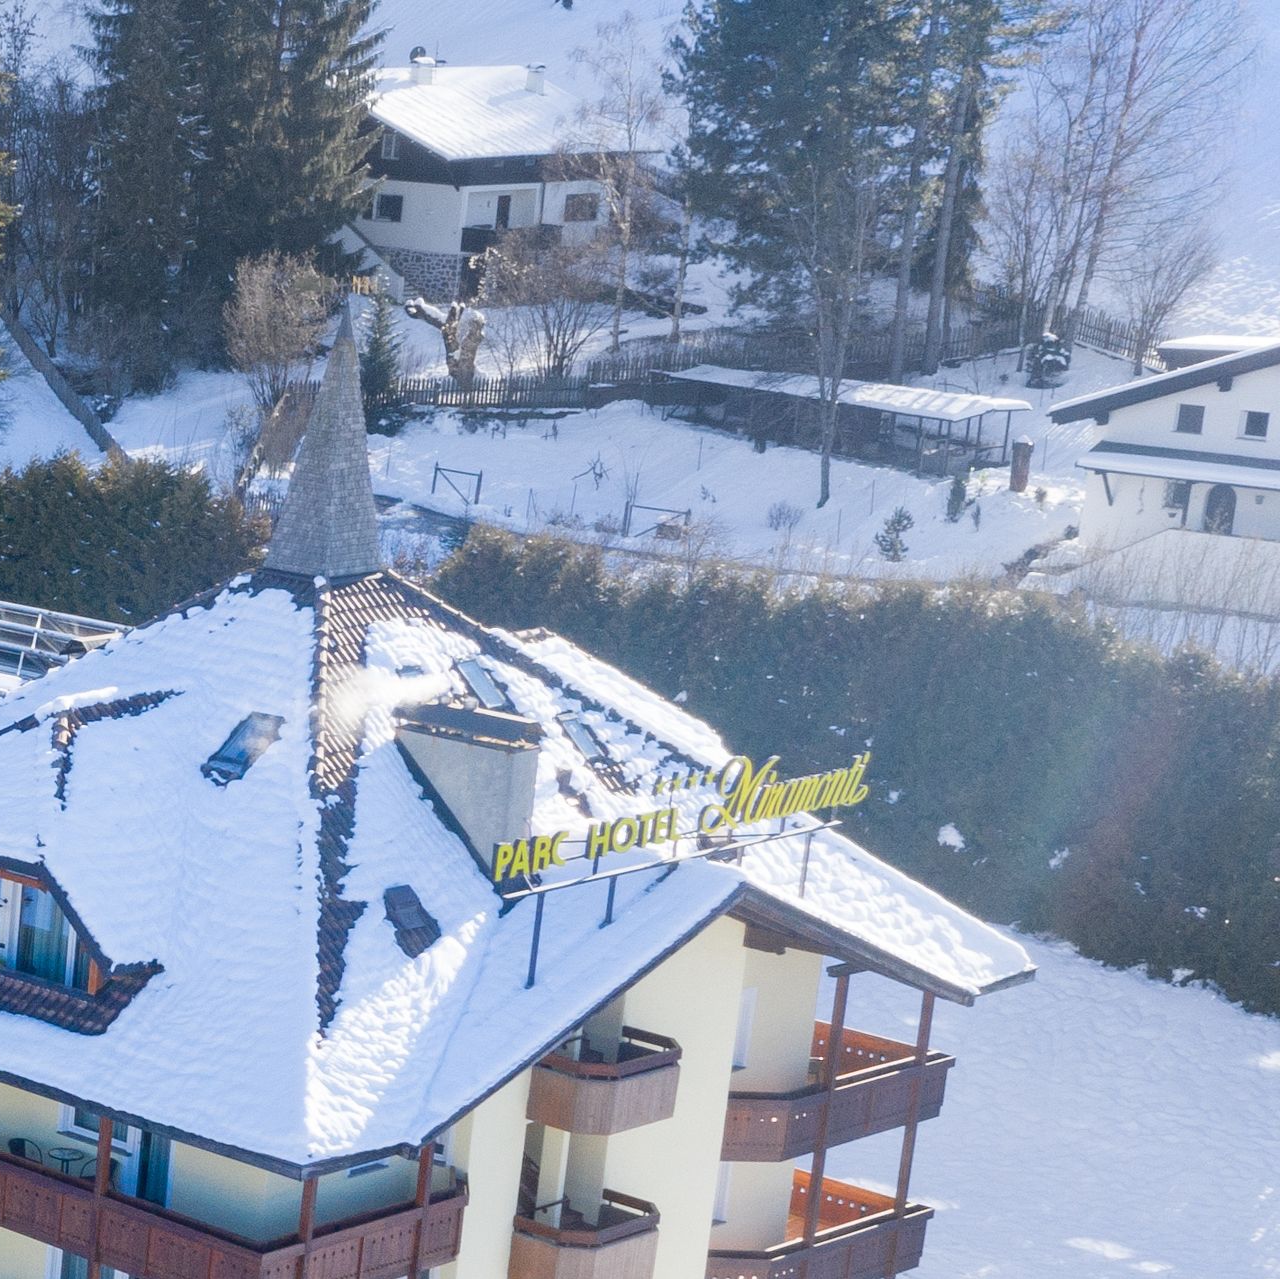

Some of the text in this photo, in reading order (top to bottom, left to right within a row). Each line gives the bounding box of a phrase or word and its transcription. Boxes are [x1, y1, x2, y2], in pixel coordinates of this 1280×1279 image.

[493, 751, 872, 882] PARC HOTEL Miramonti
